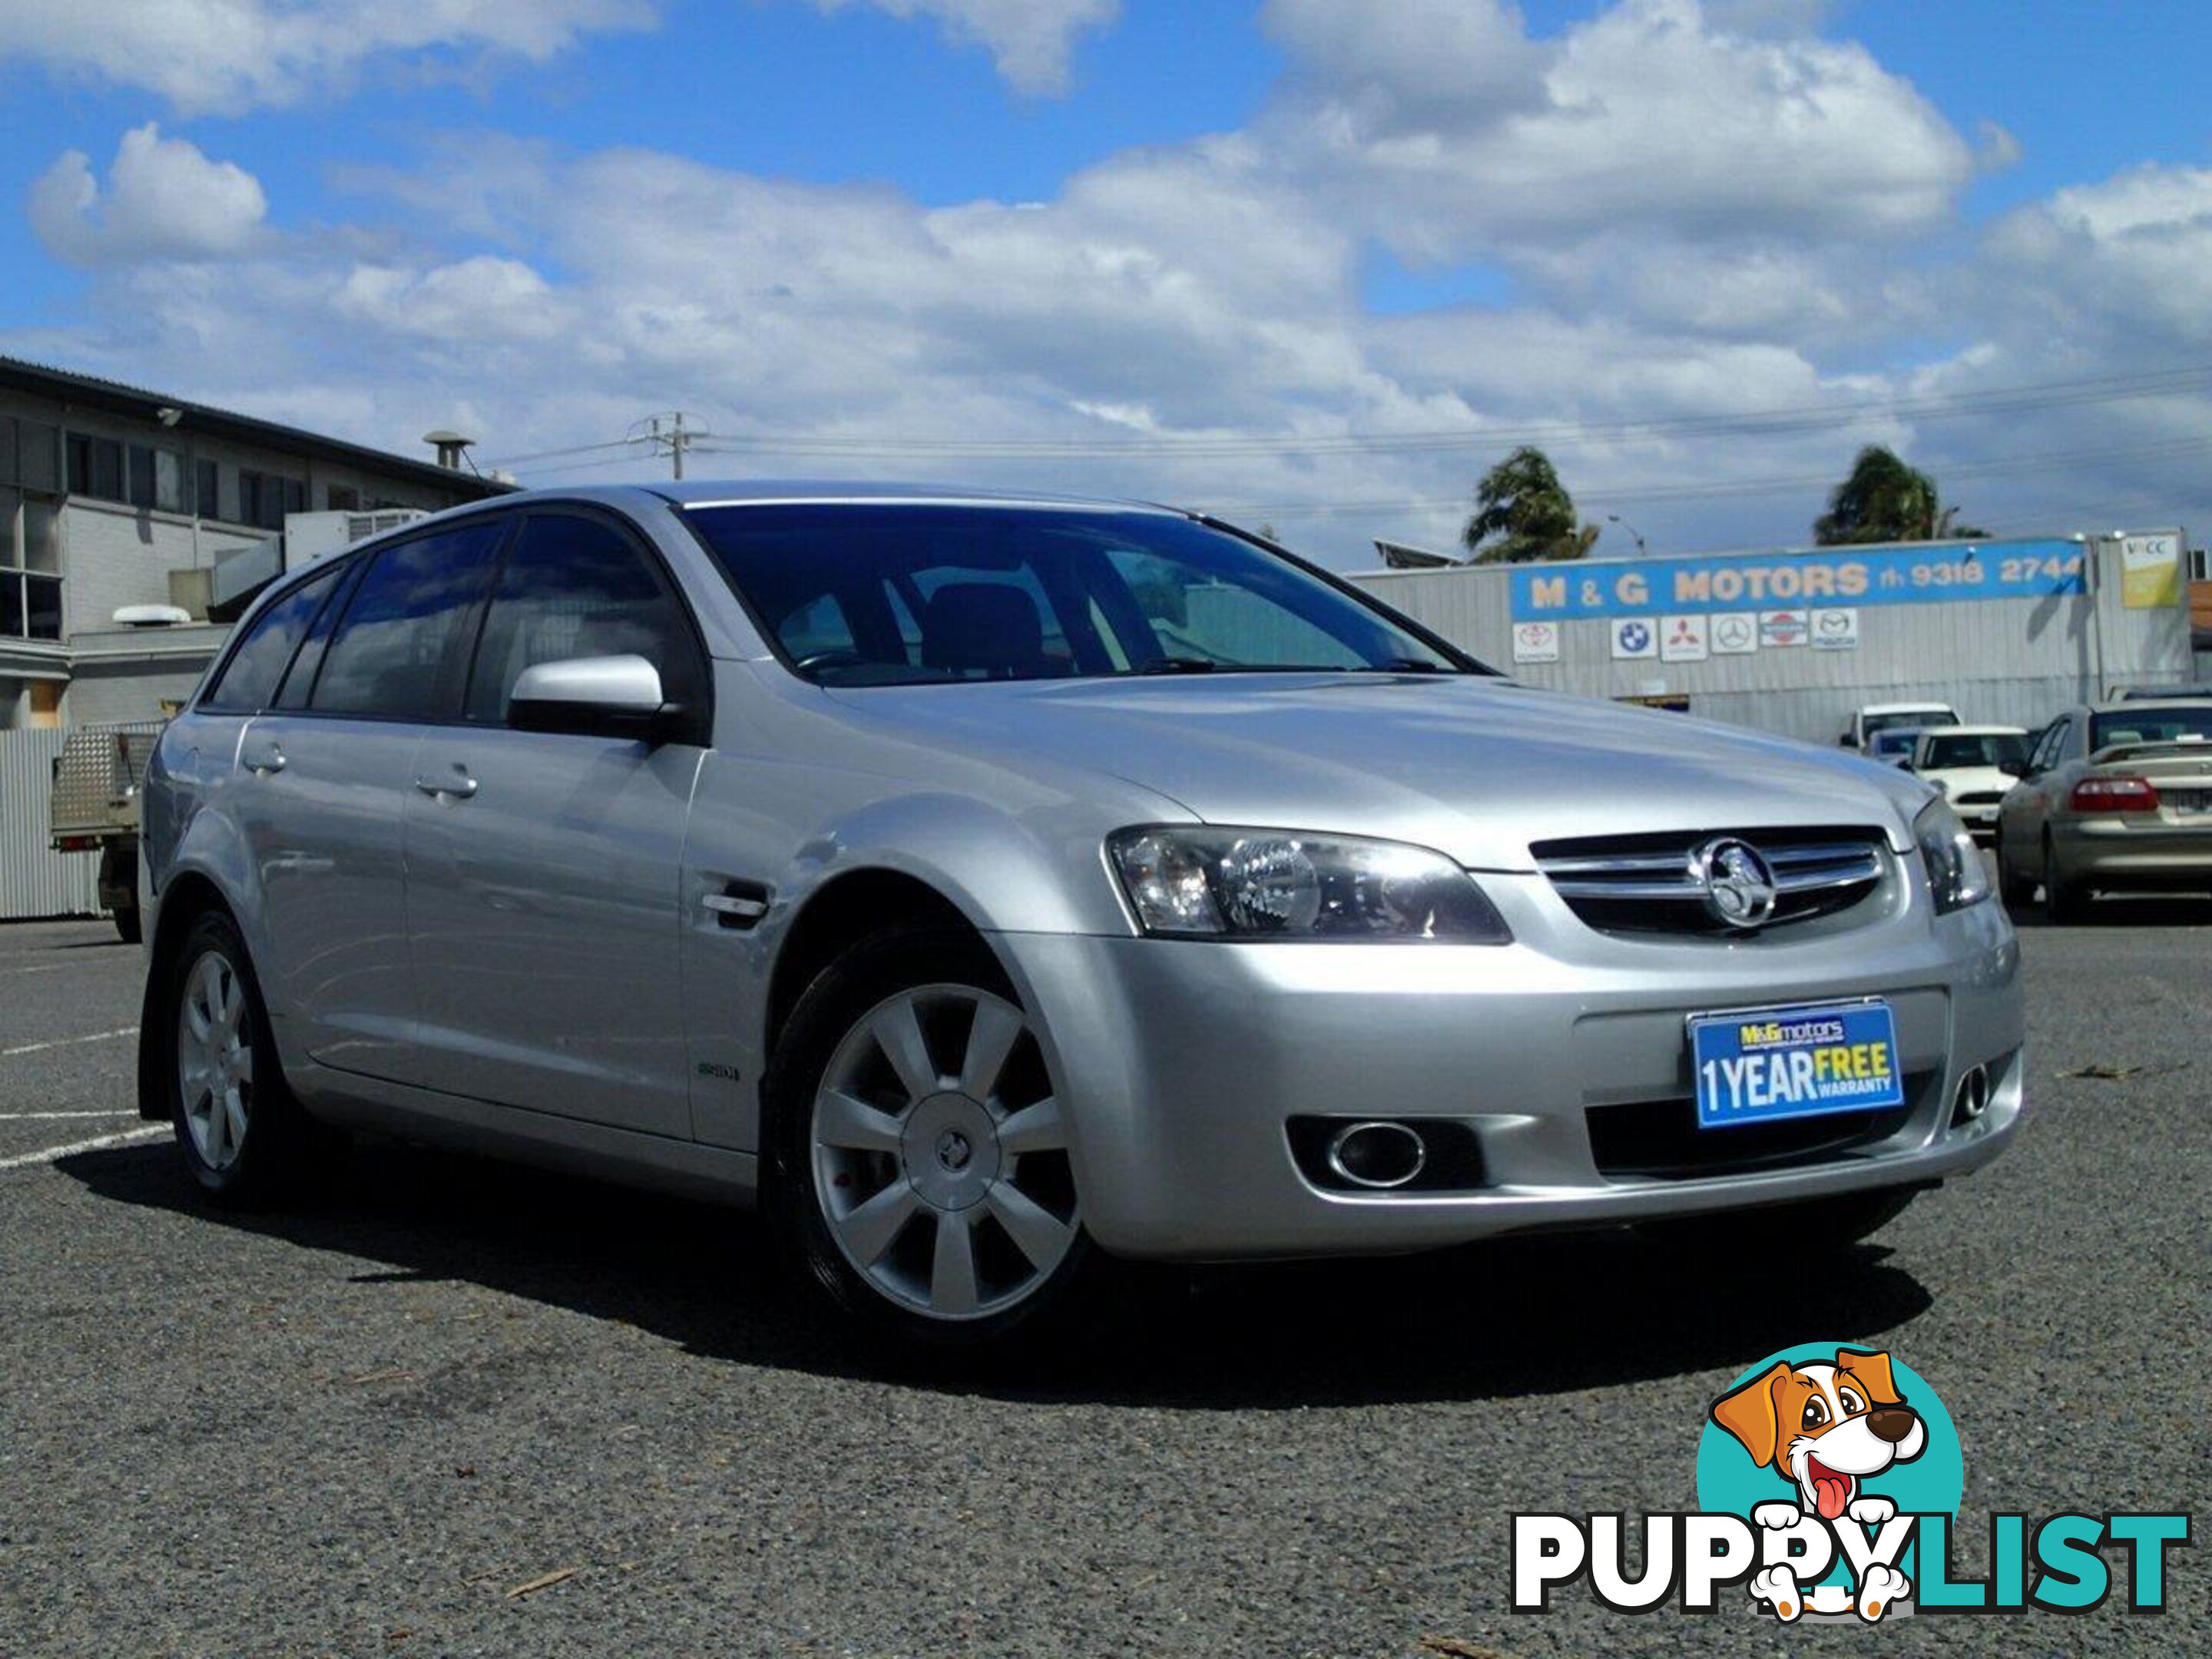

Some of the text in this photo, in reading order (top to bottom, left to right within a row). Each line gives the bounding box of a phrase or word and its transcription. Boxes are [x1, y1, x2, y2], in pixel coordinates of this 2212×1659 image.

[1532, 576, 1567, 608] M
[1581, 580, 1604, 607] &
[1615, 572, 1648, 604] G
[1674, 562, 1869, 603] MOTORS
[1910, 561, 1985, 588] 9318
[2000, 555, 2084, 583] 2744
[1701, 1041, 1890, 1112] 1 YEAR FREE
[1817, 1077, 1892, 1099] WARRANTY
